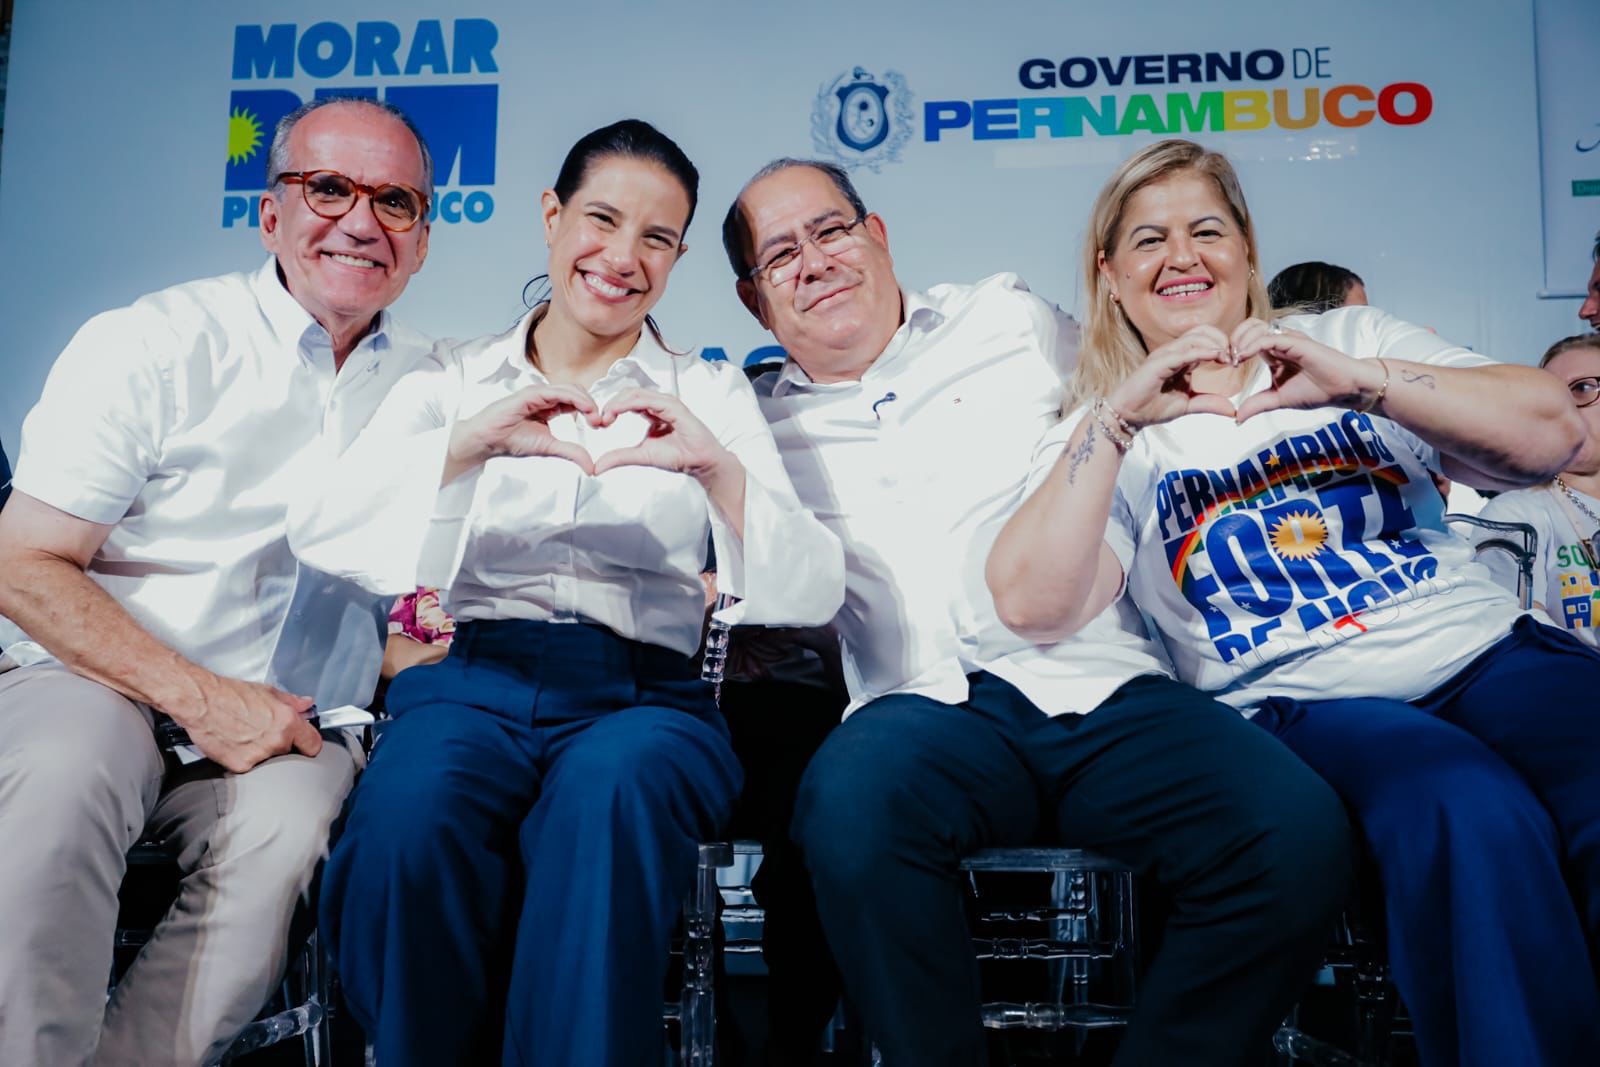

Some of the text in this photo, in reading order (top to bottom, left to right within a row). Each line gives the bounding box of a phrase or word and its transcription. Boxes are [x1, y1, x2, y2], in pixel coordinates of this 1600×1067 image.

[231, 18, 499, 80] MORAR
[1018, 46, 1332, 90] GOVERNO DE
[923, 81, 1433, 142] PERNAMBUCO
[1156, 409, 1397, 542] PERNAMBUCO
[1164, 464, 1434, 640] FORTE
